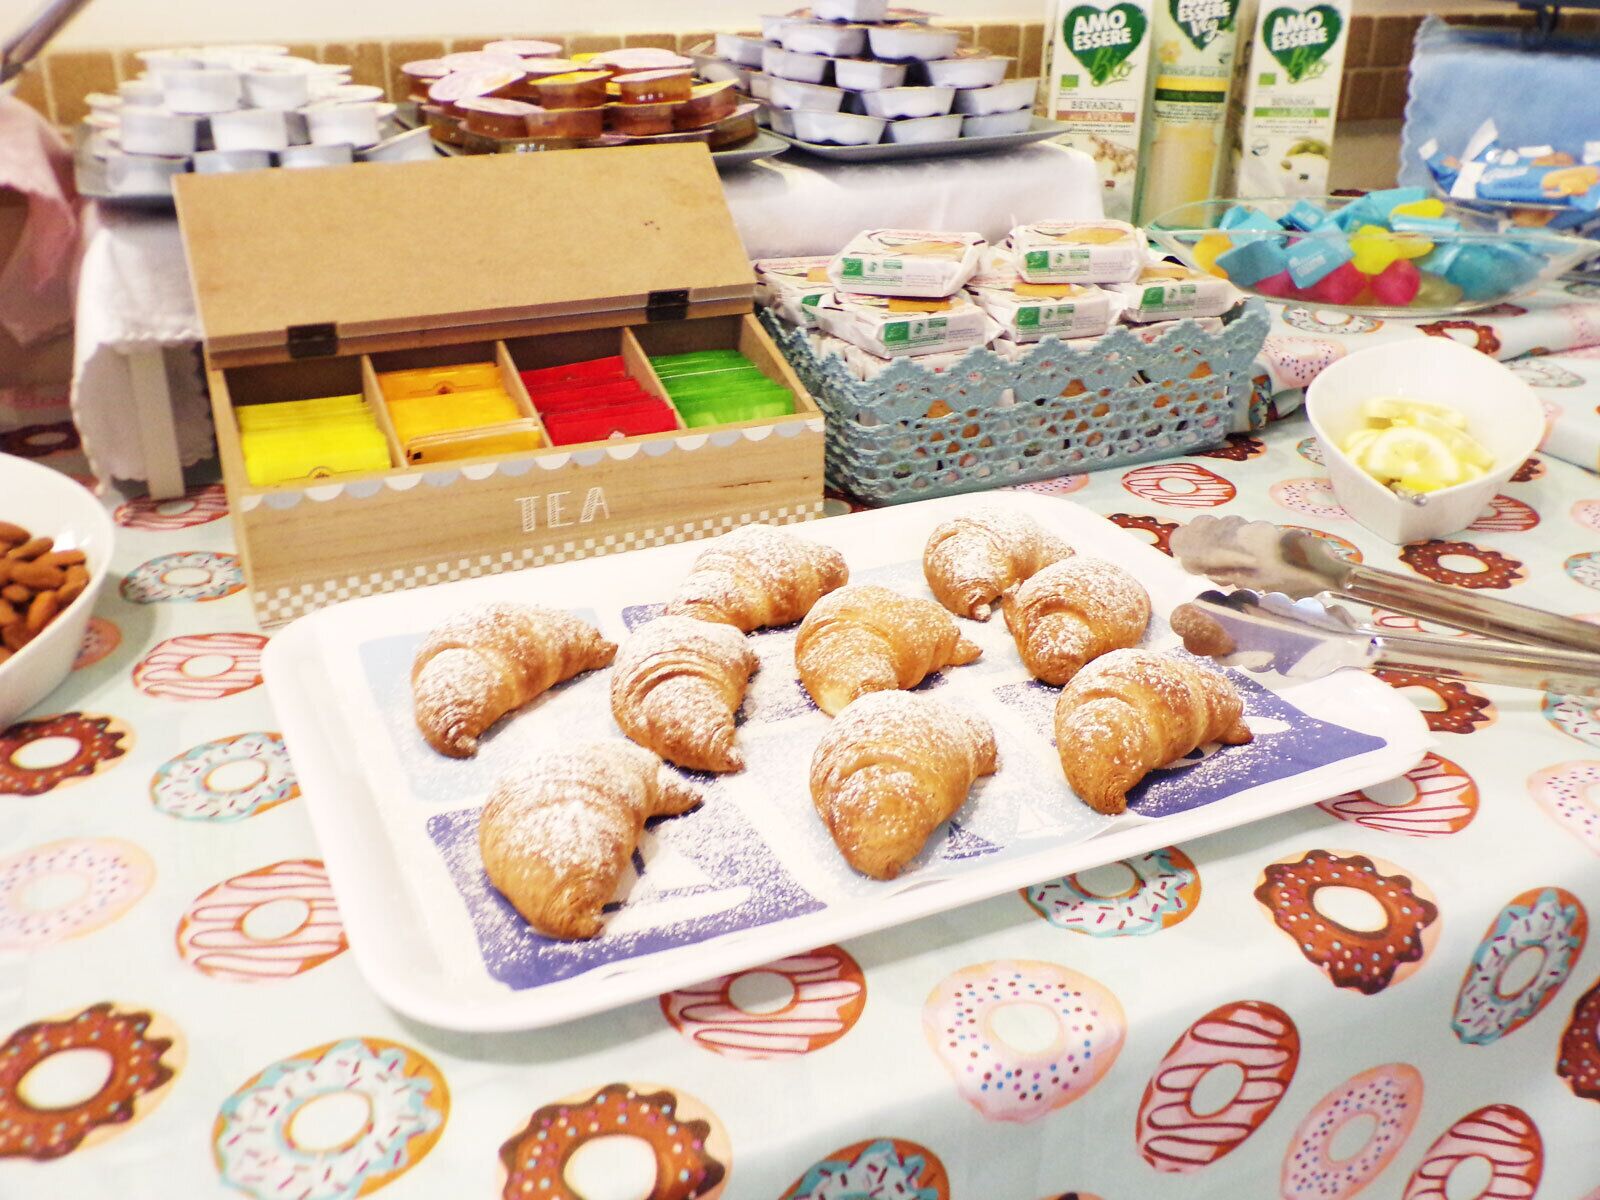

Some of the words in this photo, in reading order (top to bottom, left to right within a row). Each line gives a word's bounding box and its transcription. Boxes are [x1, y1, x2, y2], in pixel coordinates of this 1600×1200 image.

[1073, 9, 1127, 35] AMO
[1177, 1, 1231, 22] ESSERE
[1271, 10, 1323, 36] AMO
[1072, 27, 1132, 51] ESSERE
[1271, 27, 1328, 51] ESSERE
[1071, 100, 1123, 110] BEVANDA
[513, 486, 610, 532] TEA
